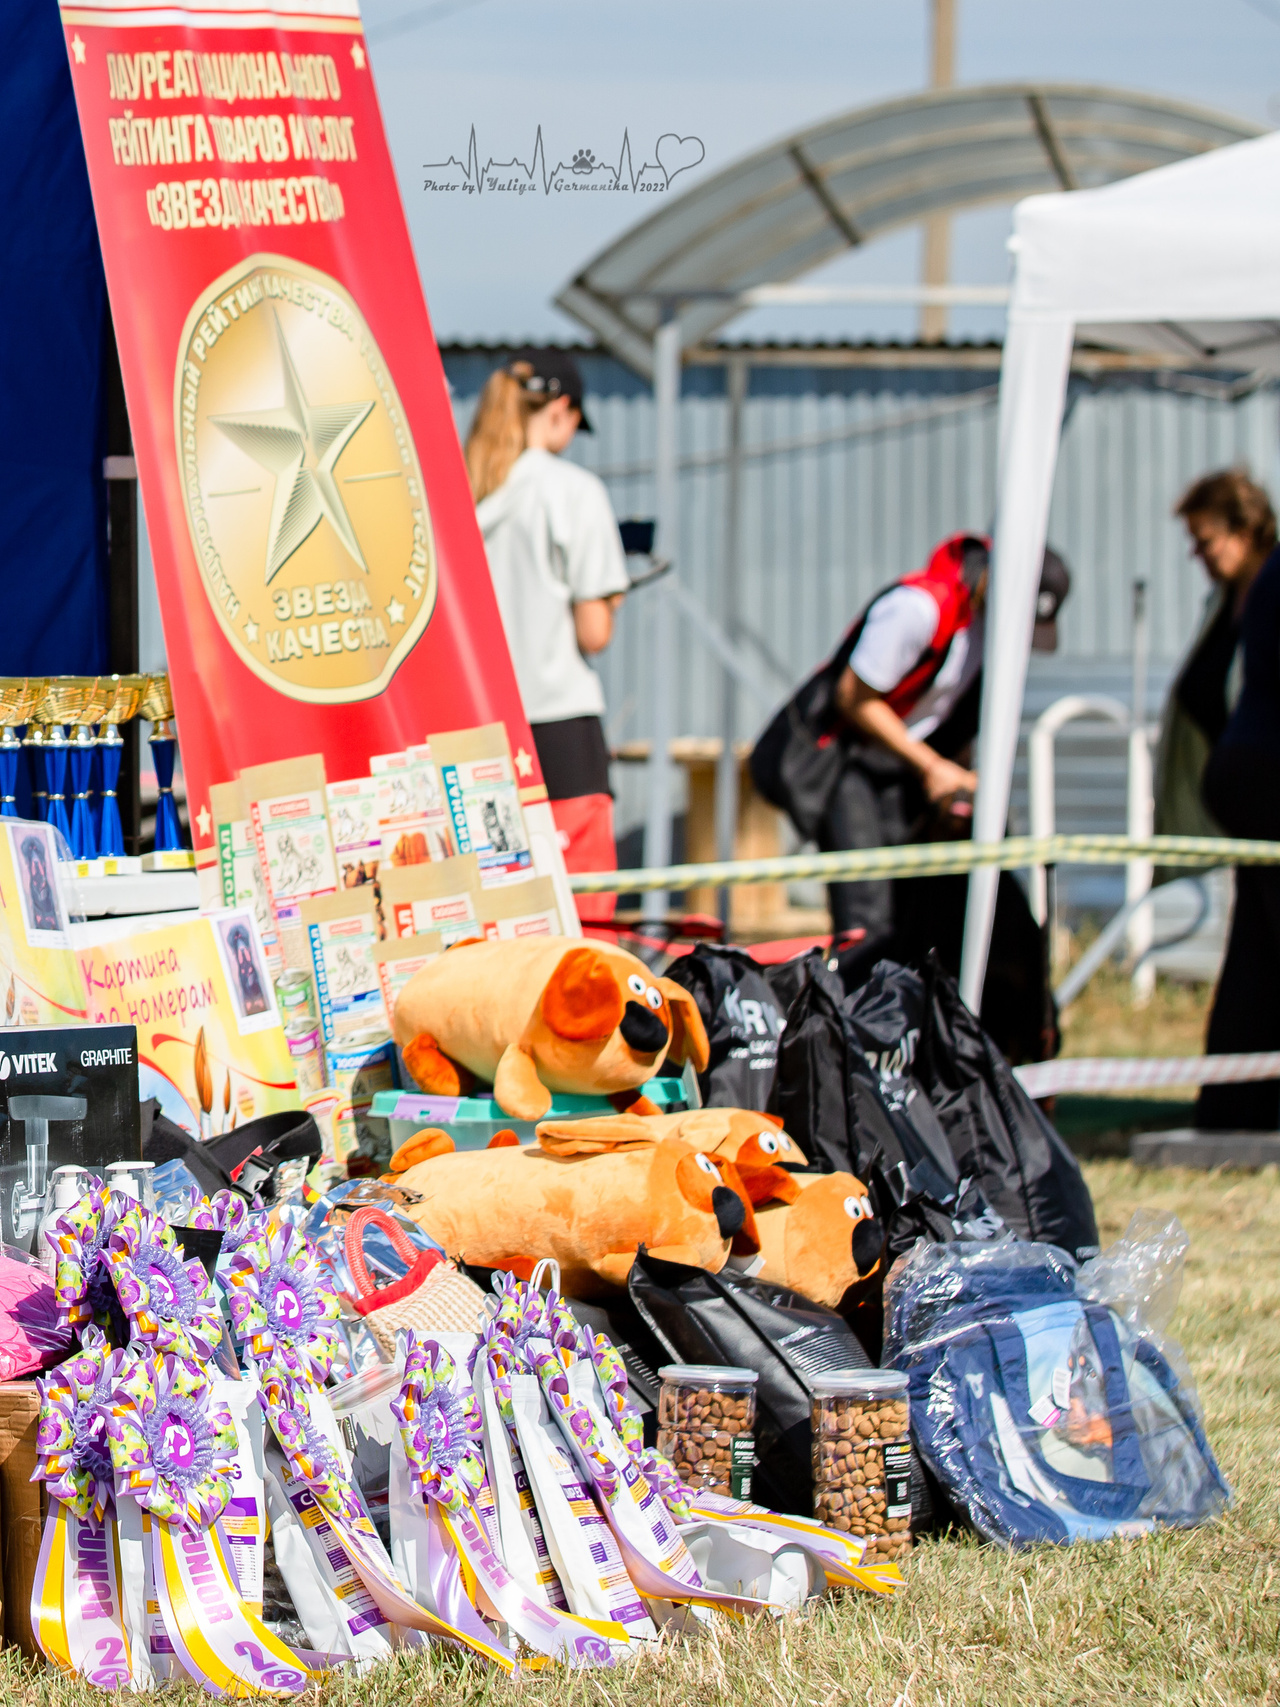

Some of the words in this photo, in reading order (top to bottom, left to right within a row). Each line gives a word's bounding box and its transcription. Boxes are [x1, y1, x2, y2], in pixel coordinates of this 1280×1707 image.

[109, 108, 214, 166] РЕЙТИНГА
[272, 579, 373, 622] ЗВЕЗДА
[265, 616, 391, 663] КАЧЕСТВА
[81, 948, 180, 994] Картина
[130, 978, 219, 1025] номерам
[11, 1052, 58, 1075] VITEK
[80, 1047, 133, 1068] GRAPHITE
[181, 1524, 234, 1625] UNIOR
[461, 1520, 515, 1589] OPEN
[95, 1636, 127, 1667] 2
[233, 1640, 278, 1673] 2
